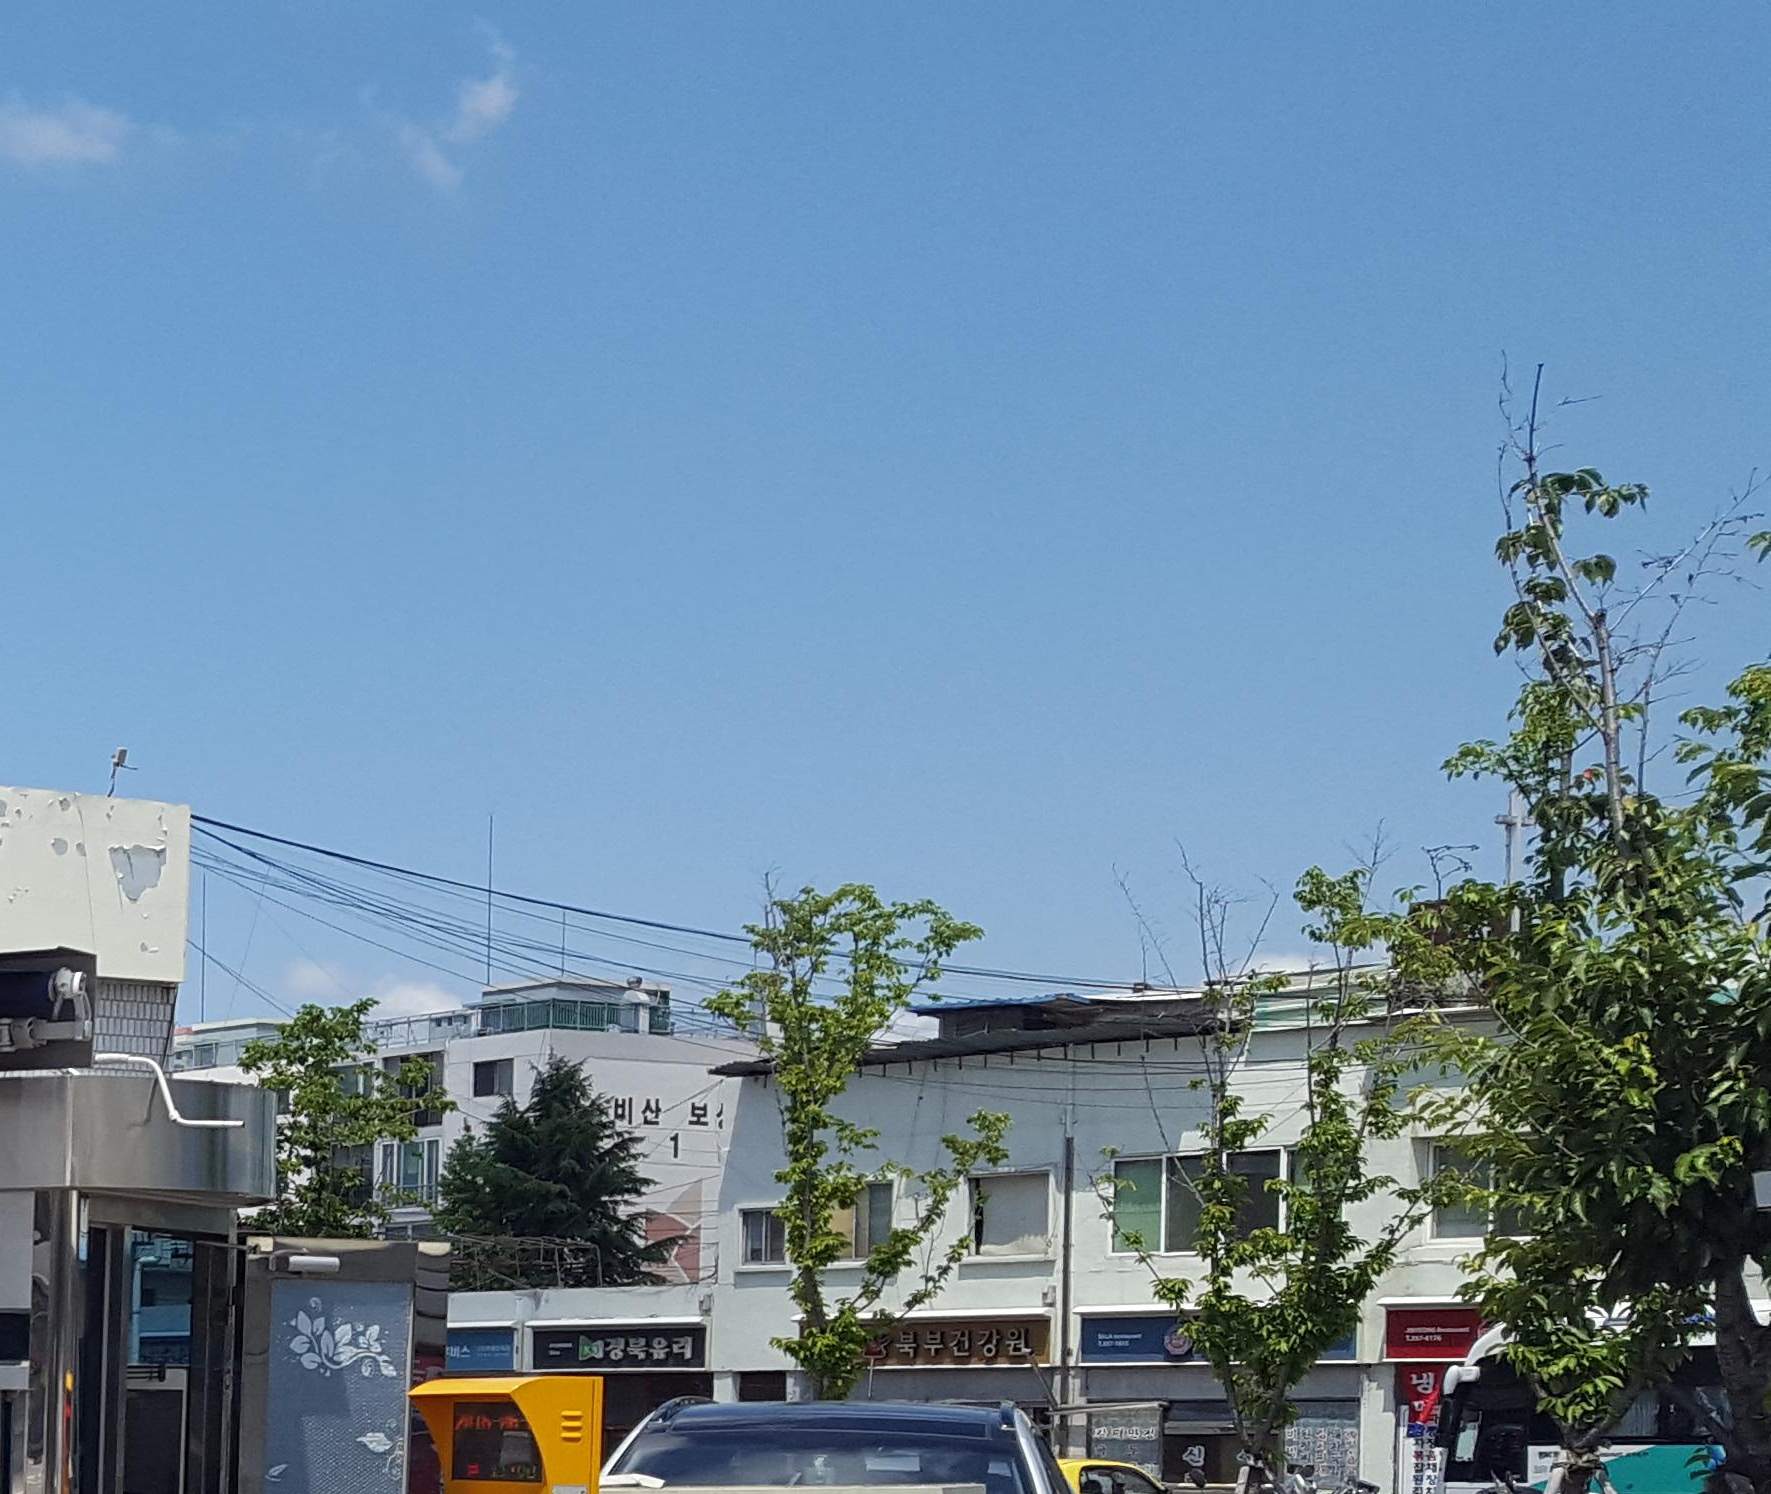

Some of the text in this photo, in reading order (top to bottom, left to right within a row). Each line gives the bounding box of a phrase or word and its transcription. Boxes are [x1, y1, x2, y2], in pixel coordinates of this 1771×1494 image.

[614, 1096, 662, 1126] 비산
[669, 1132, 679, 1159] 1
[605, 1335, 694, 1361] 경북유리
[896, 1328, 1032, 1358] 북부건강원
